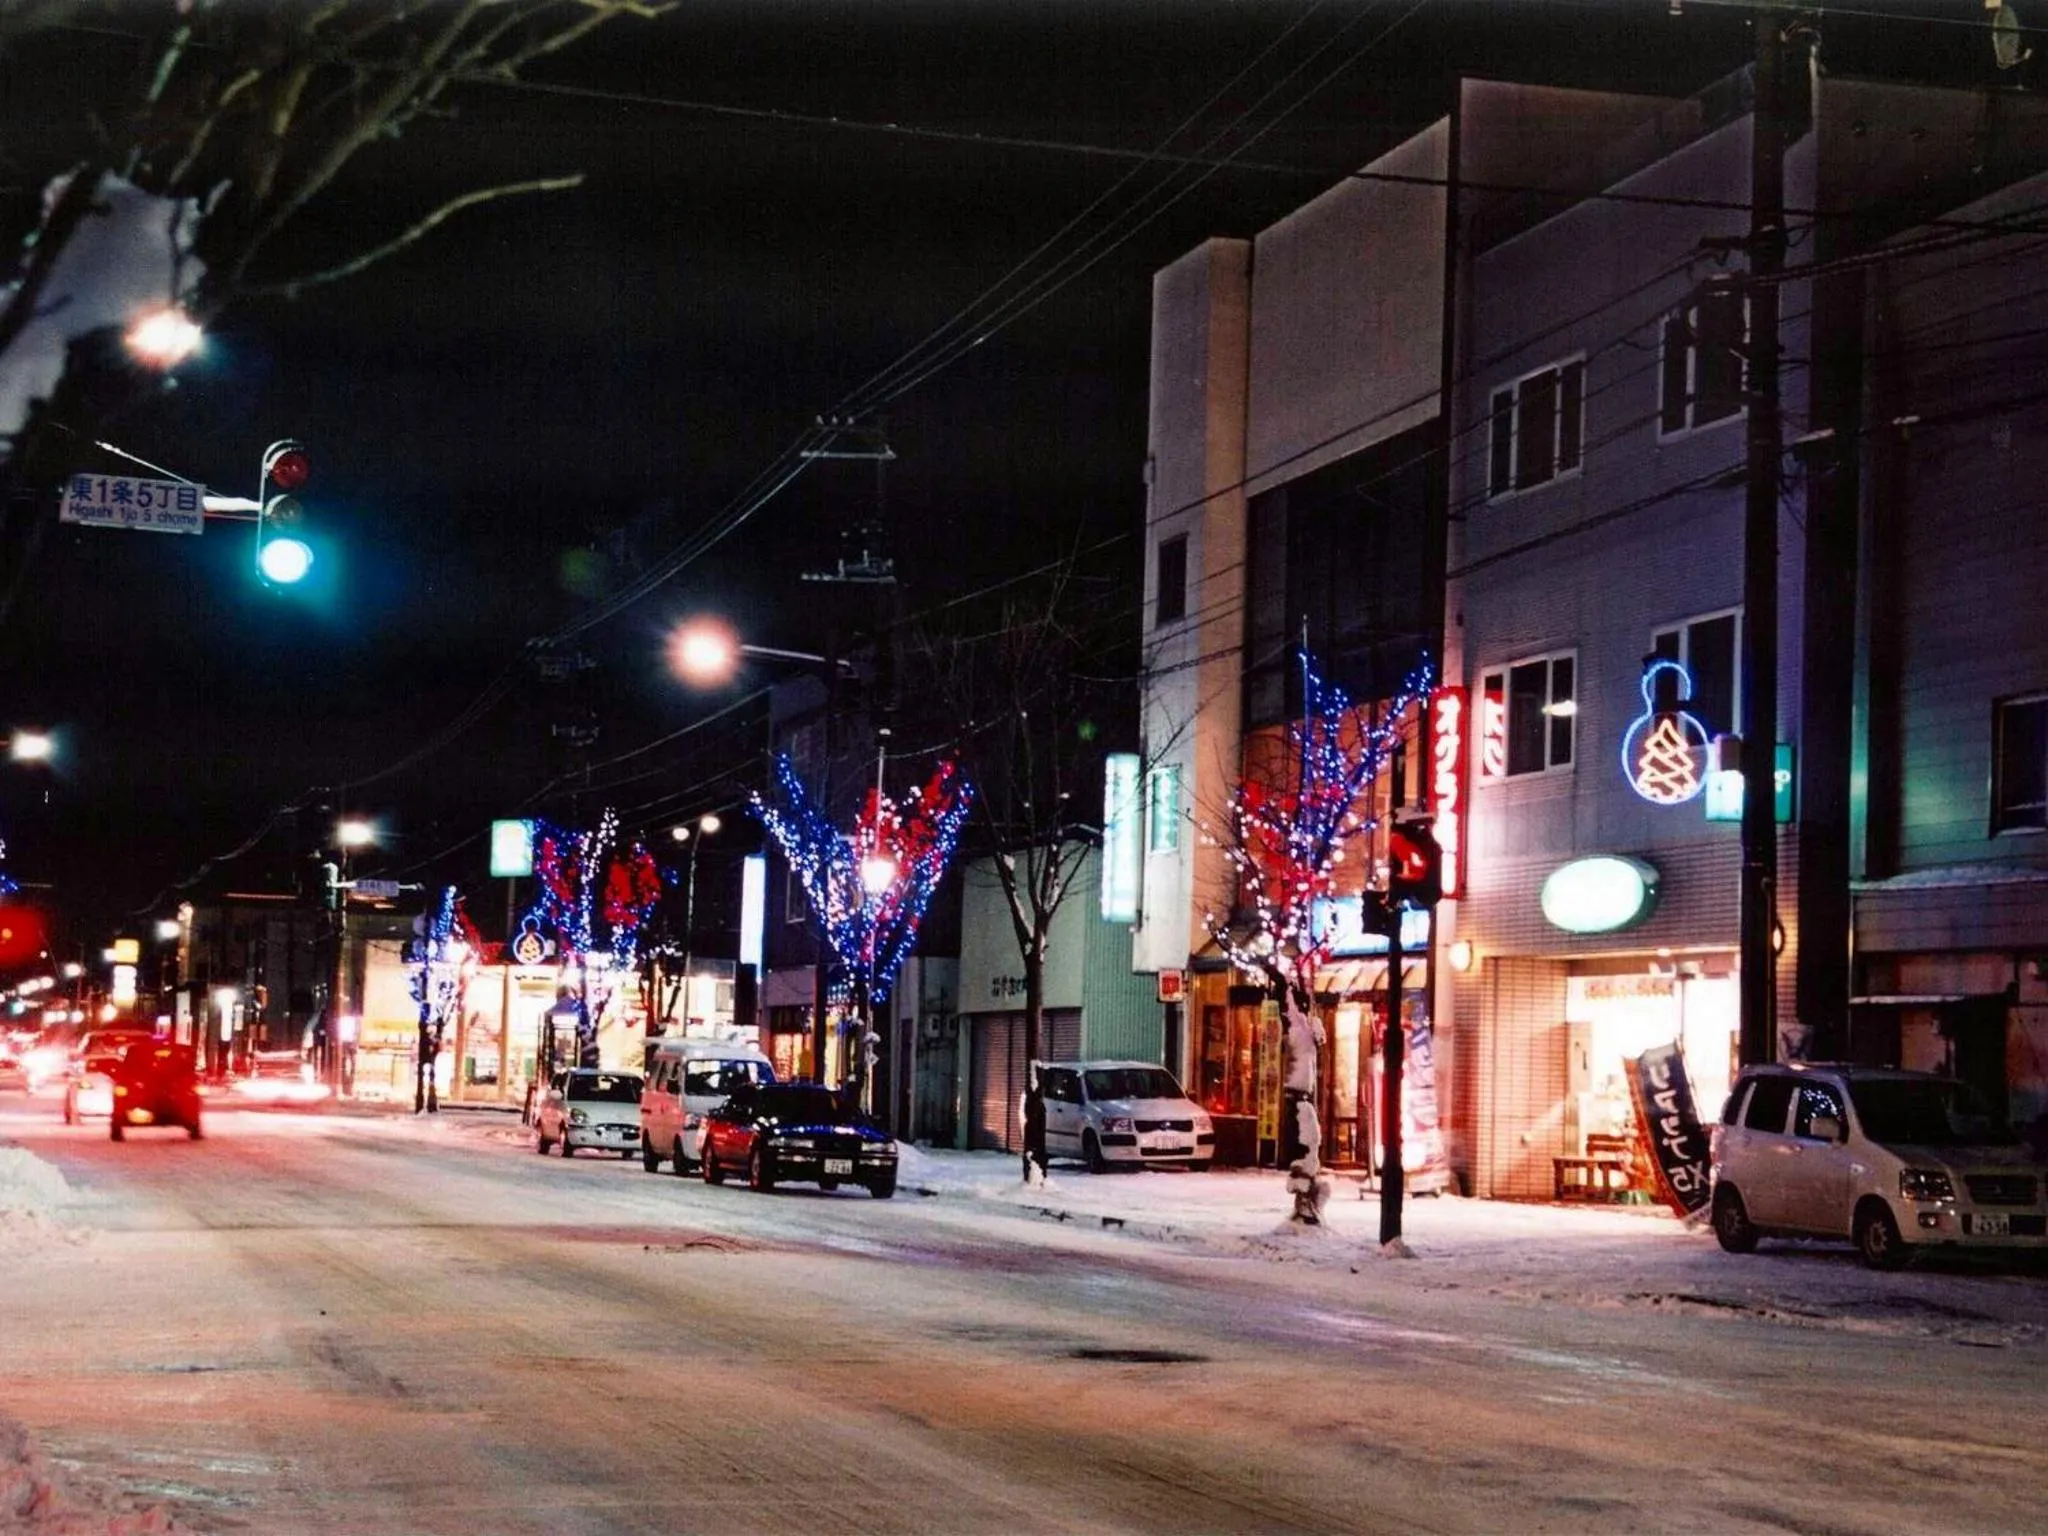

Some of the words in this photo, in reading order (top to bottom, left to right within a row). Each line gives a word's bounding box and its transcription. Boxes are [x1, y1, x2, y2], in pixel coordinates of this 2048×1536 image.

[71, 477, 198, 511] 東1条5丁目
[69, 502, 113, 519] Higashi
[143, 508, 152, 521] 5
[157, 510, 198, 526] chome
